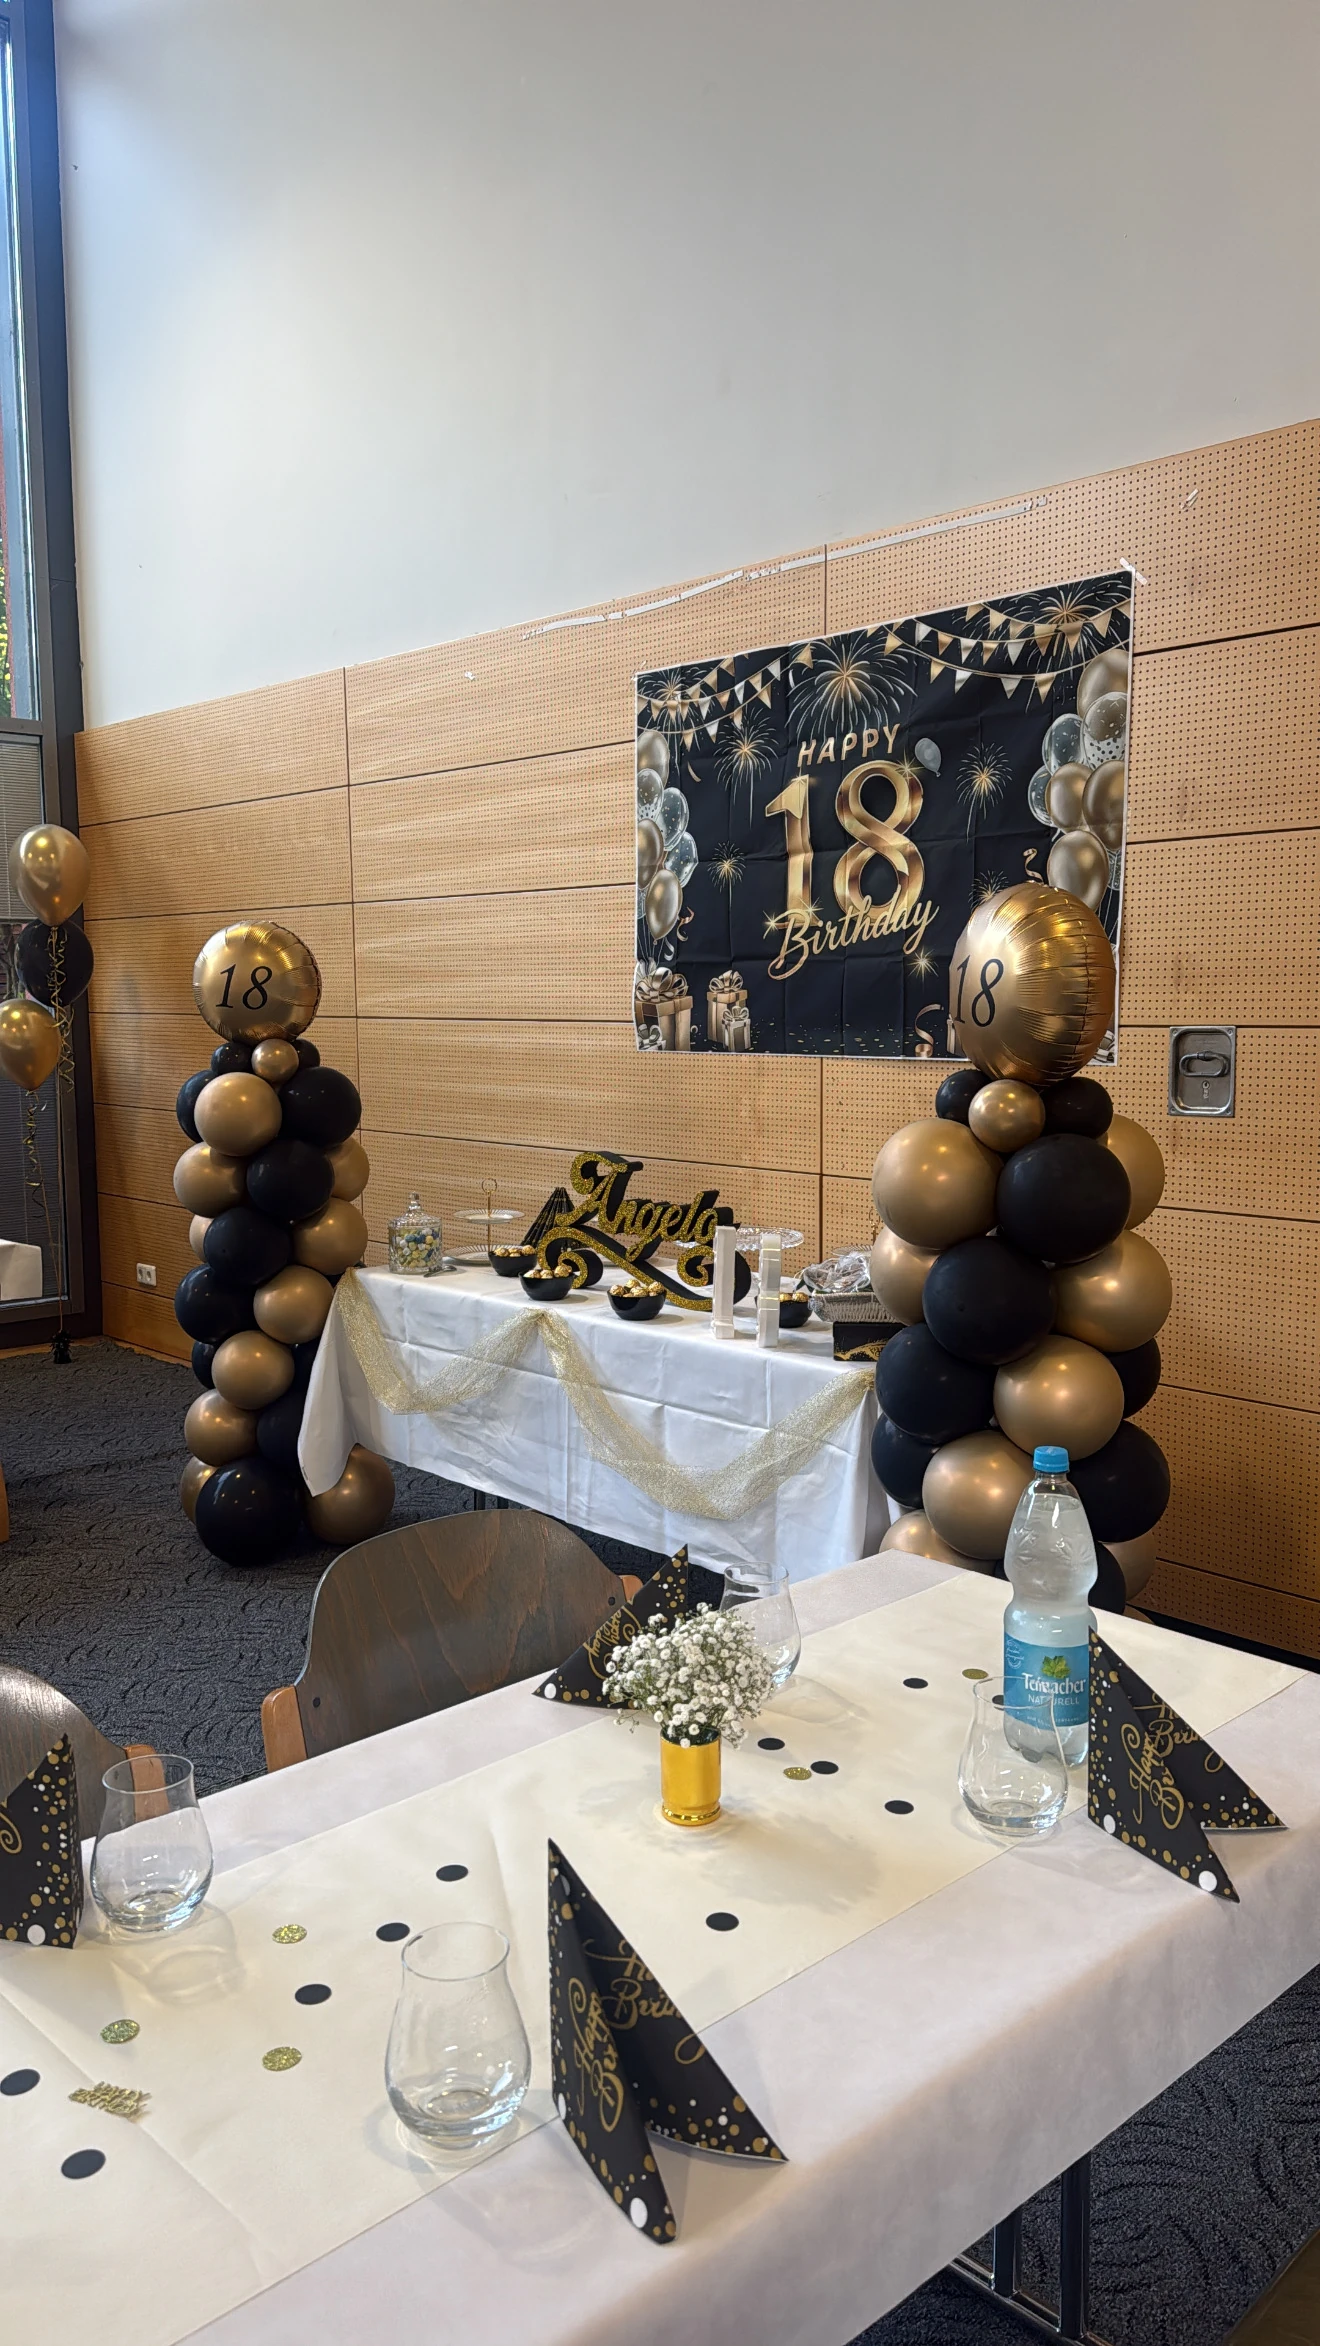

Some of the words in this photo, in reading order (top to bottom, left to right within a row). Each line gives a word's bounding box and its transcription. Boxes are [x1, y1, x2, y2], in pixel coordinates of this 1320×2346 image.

[797, 722, 902, 768] HAPPY
[765, 759, 925, 928] 18
[763, 883, 940, 981] Birthday
[215, 963, 273, 1011] 18
[953, 954, 1005, 1028] 18
